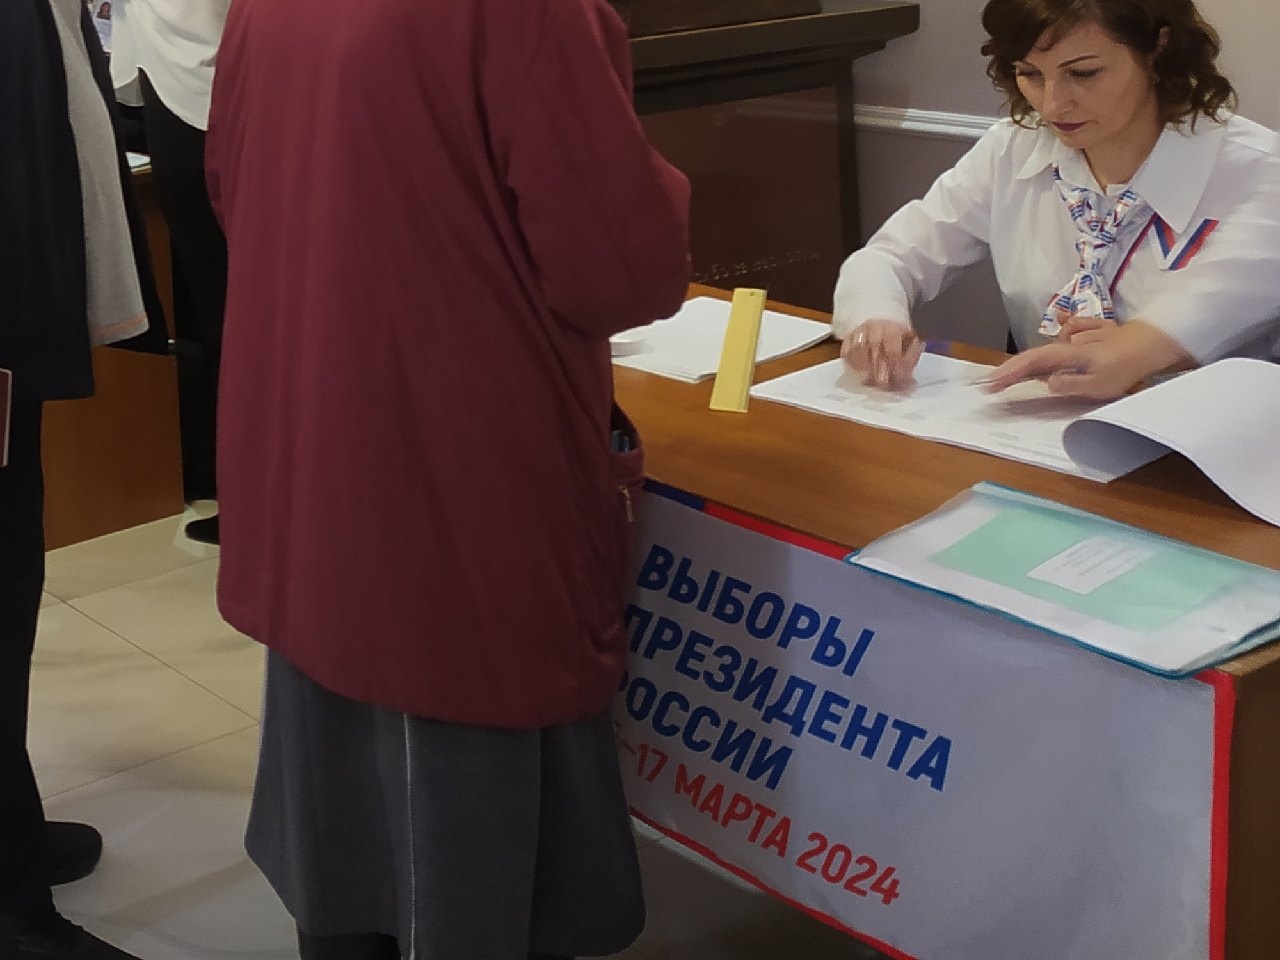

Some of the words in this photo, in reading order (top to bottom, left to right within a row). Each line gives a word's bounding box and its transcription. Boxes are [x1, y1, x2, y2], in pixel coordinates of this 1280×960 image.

[636, 543, 875, 678] ВЫБОРЫ
[622, 671, 793, 792] ОССИИ
[623, 603, 953, 792] ПРЕЗИДЕНТА
[674, 763, 792, 859] МАРТА
[795, 832, 901, 906] 2024
